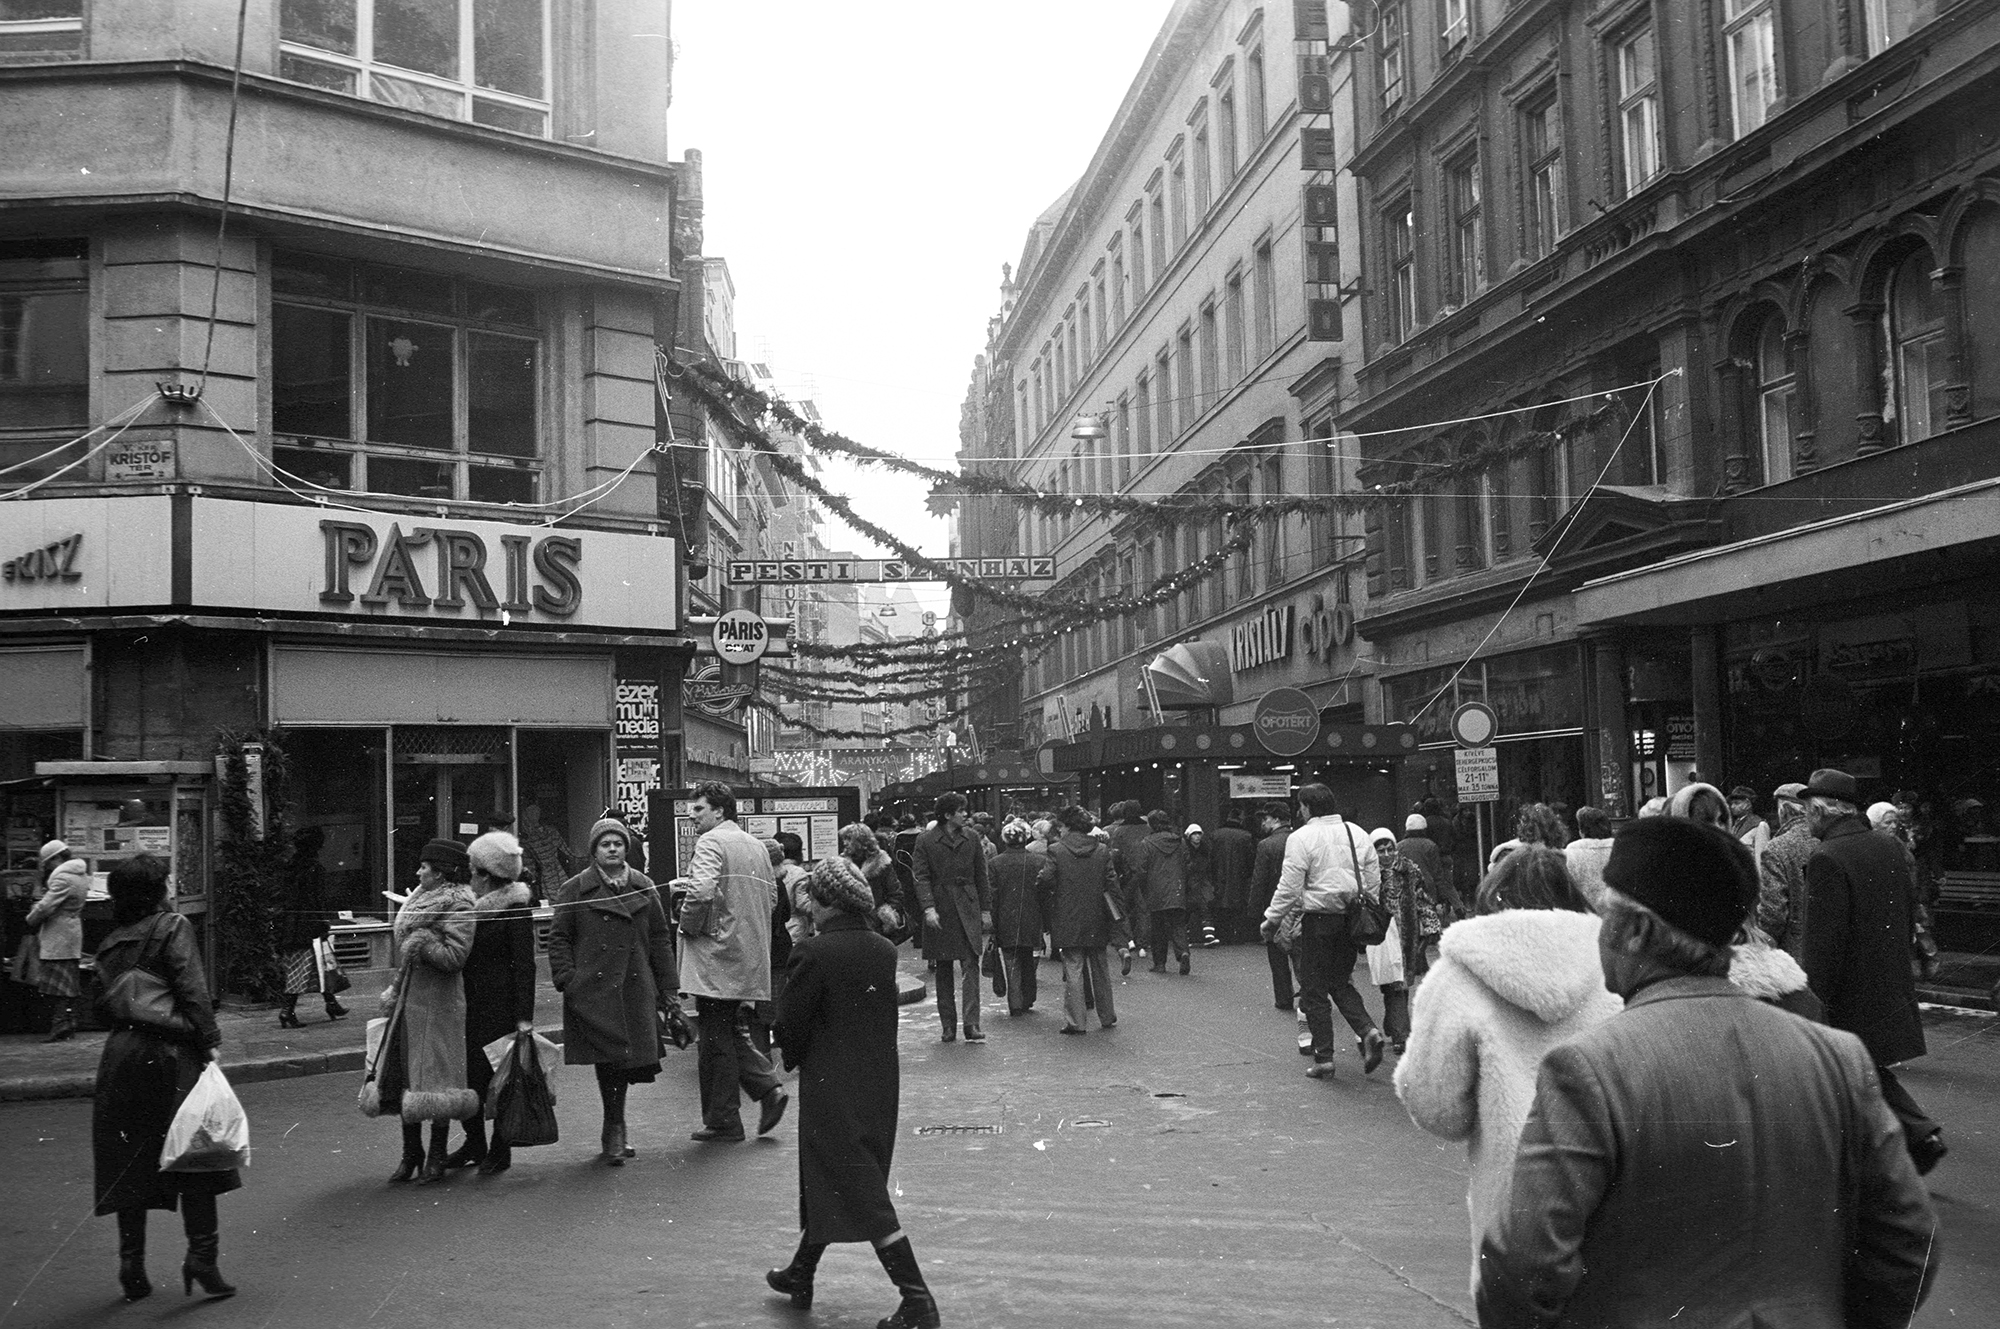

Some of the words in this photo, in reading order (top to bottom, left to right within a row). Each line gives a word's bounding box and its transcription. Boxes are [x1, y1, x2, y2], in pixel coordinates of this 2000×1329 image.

[319, 519, 582, 616] PÁRIS
[732, 563, 850, 580] PESTI
[884, 559, 1051, 579] SZNHÁZ
[719, 618, 764, 641] PÁRIS
[1228, 604, 1292, 674] KRISTÁLY
[616, 716, 659, 734] media
[1260, 713, 1311, 728] OFOTÉRT
